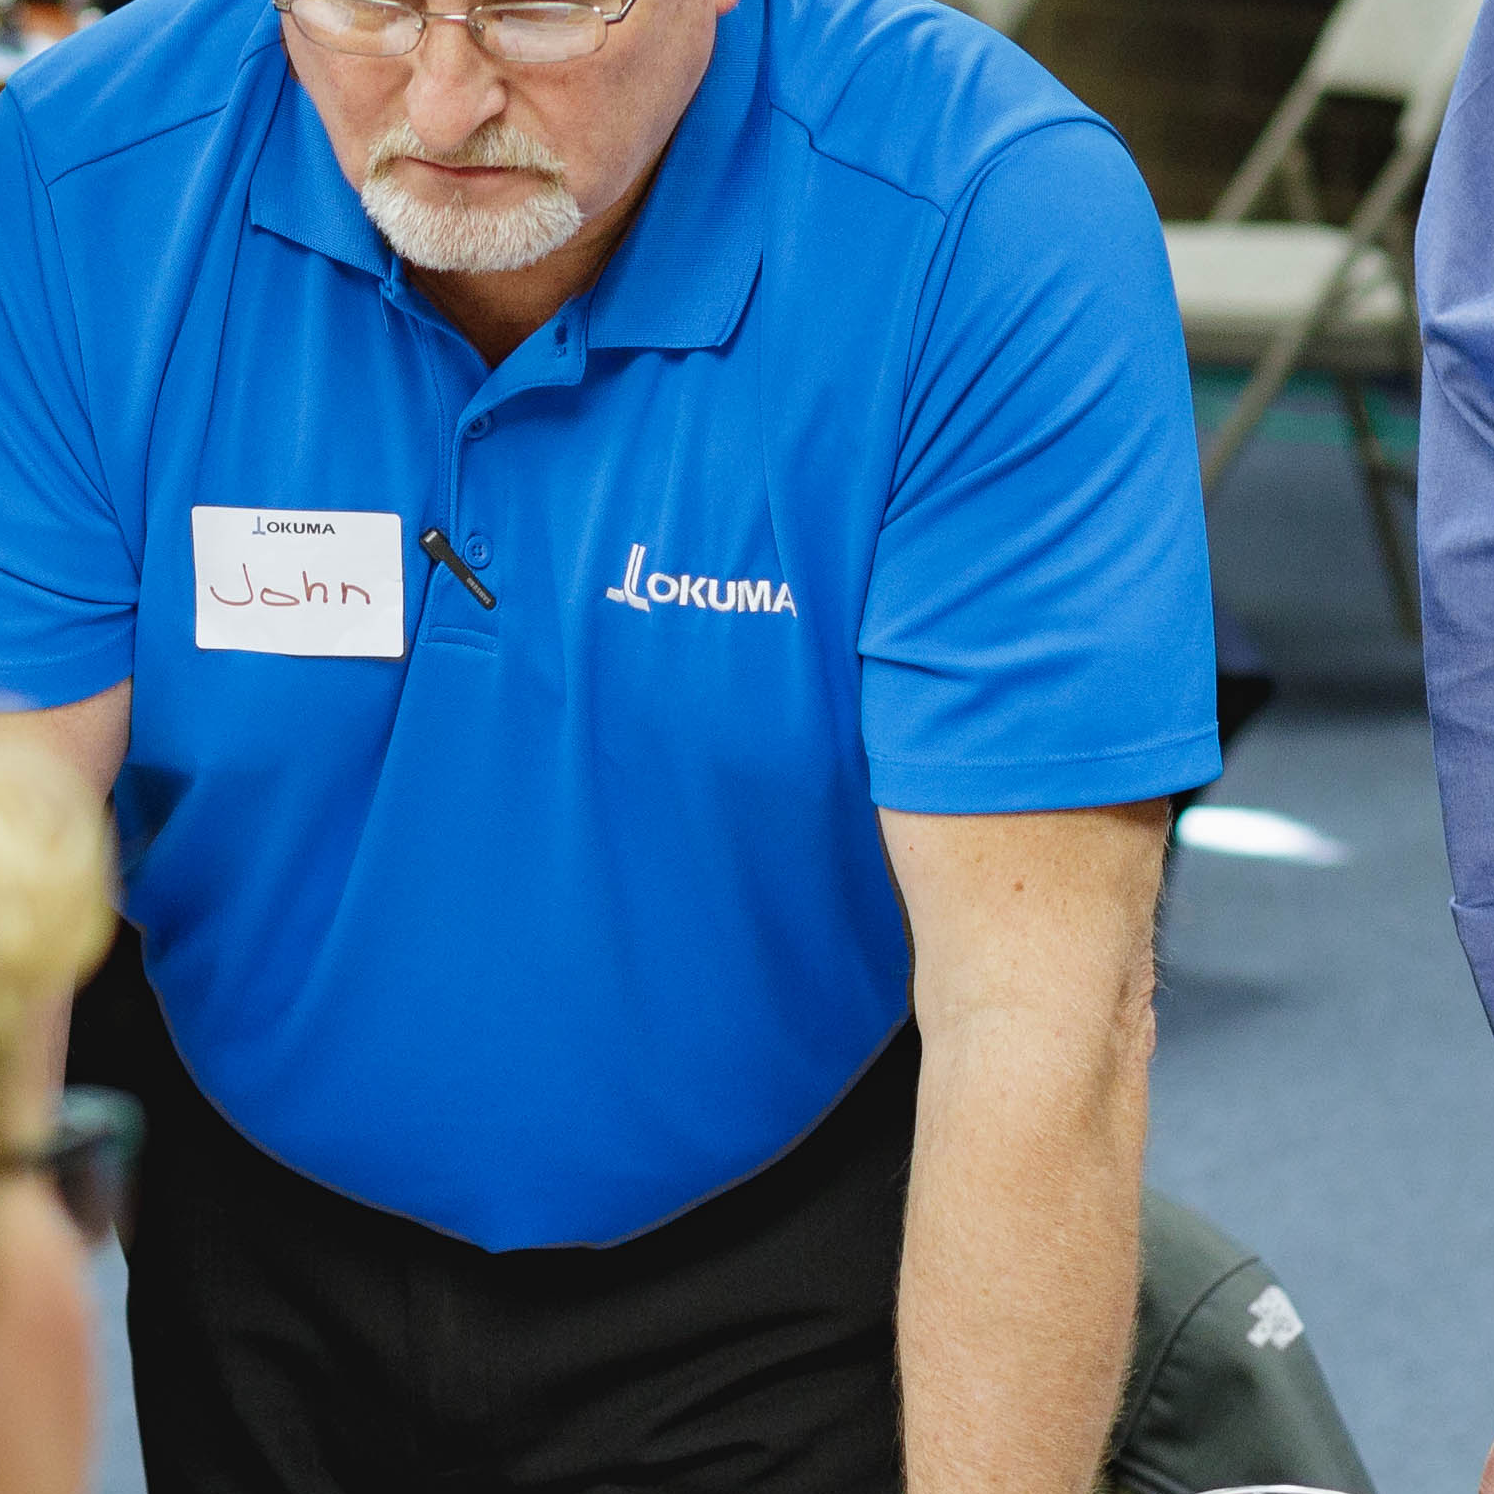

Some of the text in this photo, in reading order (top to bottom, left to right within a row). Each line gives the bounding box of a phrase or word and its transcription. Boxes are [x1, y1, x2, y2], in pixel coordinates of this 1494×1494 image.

[266, 521, 336, 535] OKUMA
[209, 563, 371, 607] John
[646, 572, 798, 619] OKUMA
